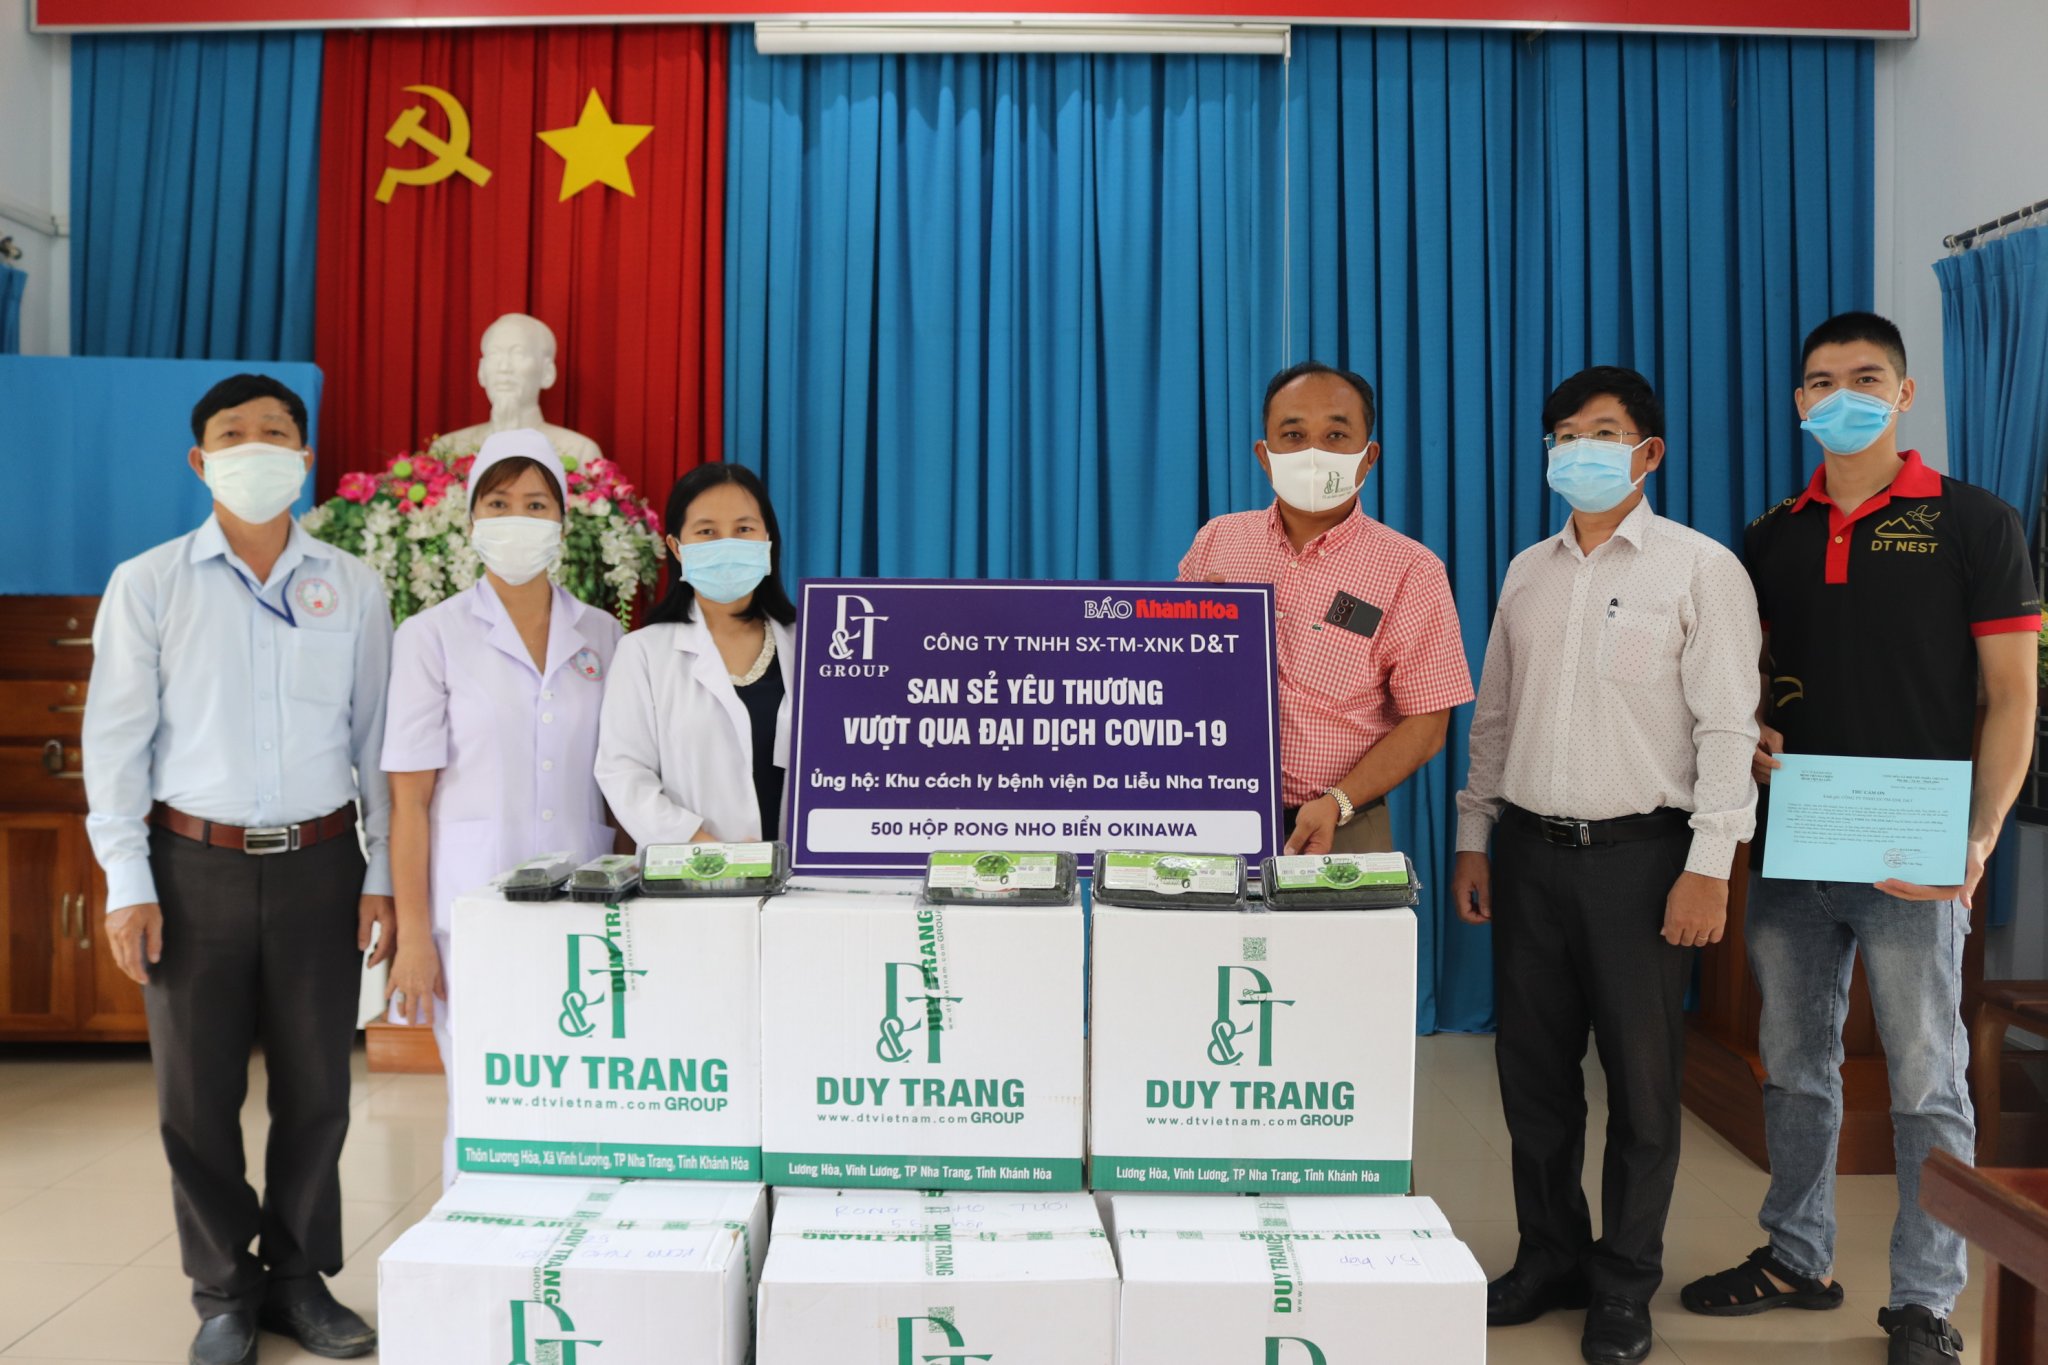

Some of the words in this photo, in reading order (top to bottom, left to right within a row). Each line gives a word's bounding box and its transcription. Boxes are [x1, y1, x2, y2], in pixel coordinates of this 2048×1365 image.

[1871, 540, 1893, 552] DT
[1896, 540, 1939, 554] NEST
[1084, 596, 1133, 620] BÁO
[923, 632, 979, 652] CÔNG
[984, 636, 1009, 652] TY
[1015, 636, 1070, 652] TNHH
[1076, 636, 1185, 653] SX-TM-XNK
[1190, 633, 1240, 654] D&T
[819, 664, 890, 678] GROUP
[907, 678, 959, 705] SAN
[966, 671, 999, 705] SẺ
[1007, 675, 1055, 705] YÊU
[1062, 678, 1163, 706] THƯƠNG
[843, 715, 912, 751] VƯỢT
[919, 717, 971, 750] QUA
[978, 717, 1024, 752] ĐẠI
[1033, 718, 1096, 752] DỊCH
[1105, 718, 1228, 748] COVID-19
[810, 767, 847, 791] Ủng
[851, 773, 880, 791] hộ:
[885, 773, 922, 789] Khu
[924, 772, 973, 790] cách
[977, 773, 993, 793] ly
[997, 773, 1045, 793] bệnh
[1049, 773, 1088, 793] viện
[1092, 774, 1120, 791] Da
[1124, 771, 1161, 791] Liễu
[1166, 774, 1203, 791] Nha
[1208, 774, 1260, 794] Trang
[870, 821, 904, 837] 500
[908, 816, 949, 841] HỘP
[954, 821, 1009, 838] RONG
[1014, 821, 1058, 838] NHO
[1062, 814, 1102, 838] BIỂN
[1107, 821, 1198, 838] OKINAWA
[485, 1052, 570, 1089] DUY
[581, 1056, 728, 1093] TRANG
[486, 1095, 661, 1111] www.dtvietnam.com
[664, 1096, 728, 1112] GROUP
[816, 1076, 890, 1106] DUY
[900, 1078, 1025, 1109] TRANG
[1146, 1080, 1221, 1108] DUY
[1230, 1081, 1355, 1110] TRANG
[817, 1111, 968, 1124] www.dtvietnam.com
[971, 1112, 1025, 1124] GROUP
[1147, 1115, 1297, 1127] www.dtvietnam.com
[1300, 1114, 1354, 1127] GROUP
[613, 1153, 626, 1167] TP
[627, 1152, 646, 1168] Nha
[647, 1153, 676, 1172] Trang,
[699, 1155, 729, 1170] Khánh
[788, 1162, 819, 1178] Lương
[821, 1163, 843, 1178] Hòa,
[869, 1165, 901, 1179] Lương,
[904, 1165, 917, 1178] TP
[920, 1166, 939, 1178] Nha
[943, 1166, 973, 1181] Trang,
[1000, 1166, 1030, 1180] Khánh
[1116, 1166, 1146, 1182] Lương
[1149, 1167, 1170, 1181] Hòa,
[1198, 1168, 1230, 1183] Lương,
[1233, 1168, 1246, 1181] TP
[1249, 1168, 1268, 1181] Nha
[1271, 1169, 1301, 1184] Trang,
[1328, 1169, 1358, 1182] Khánh
[560, 1228, 589, 1248] DUY
[935, 1244, 954, 1276] TRANG
[543, 1248, 573, 1305] TRANG
[1271, 1272, 1293, 1313] DUY
